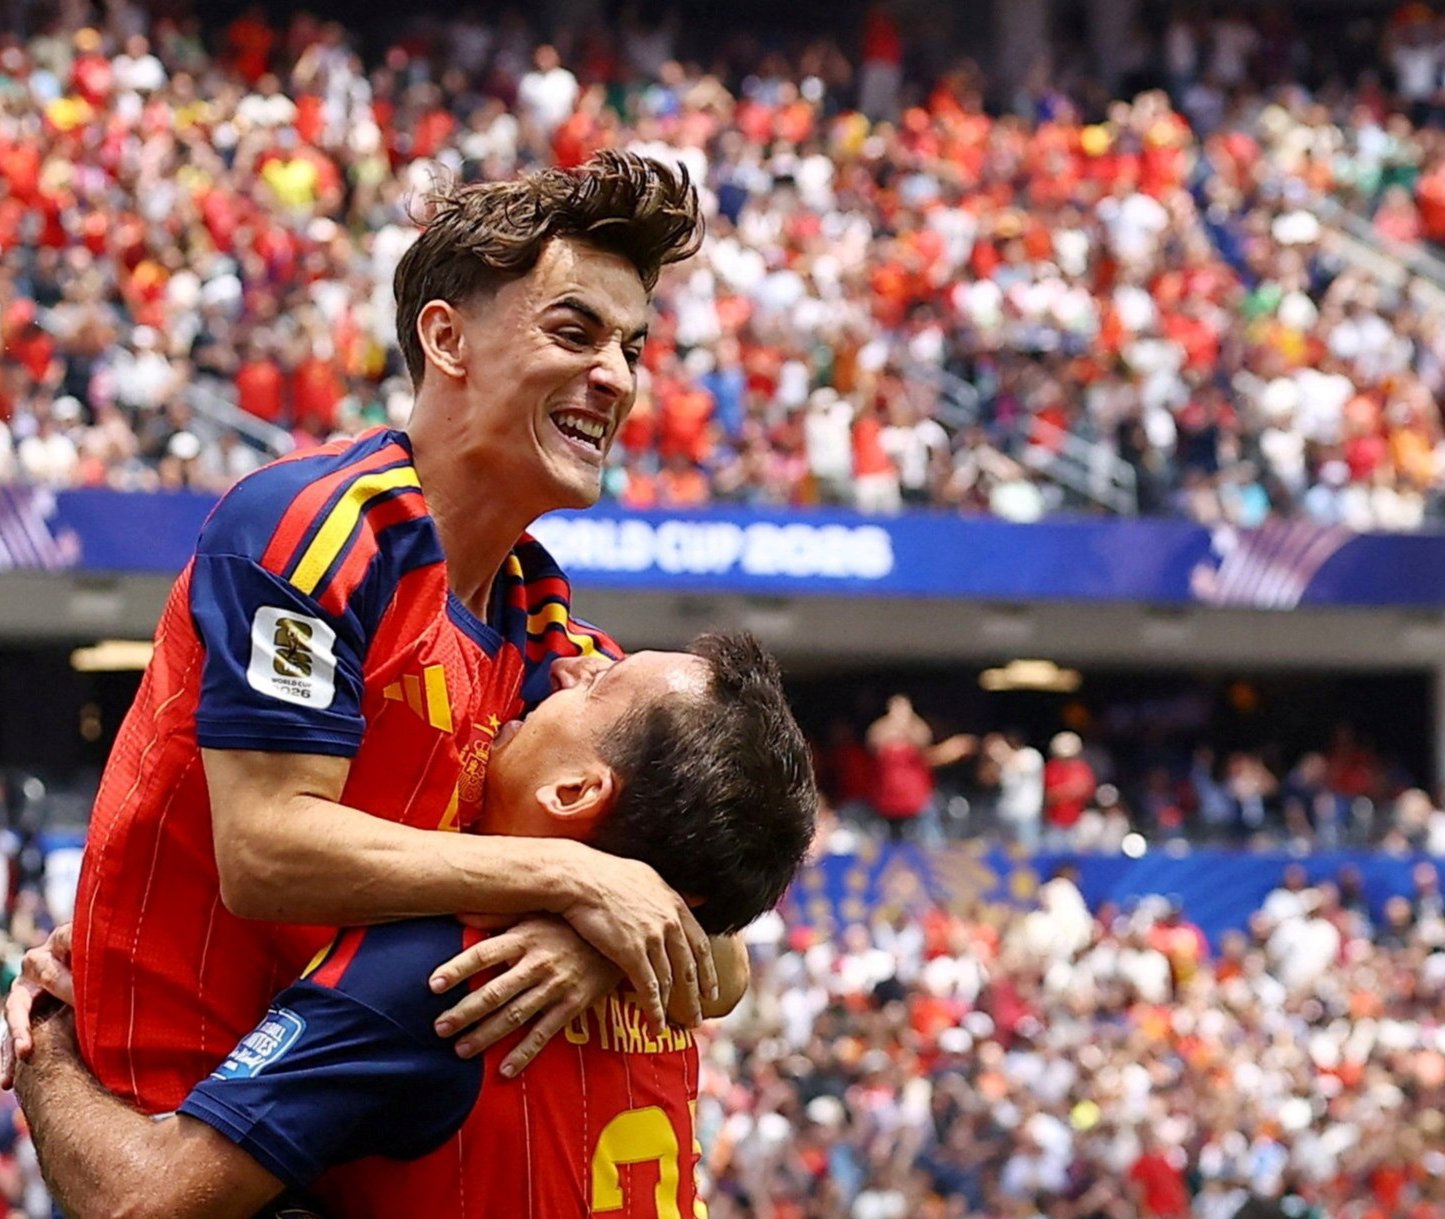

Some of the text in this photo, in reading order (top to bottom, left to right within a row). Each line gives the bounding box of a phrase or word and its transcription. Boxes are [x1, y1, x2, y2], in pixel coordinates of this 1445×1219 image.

[526, 516, 894, 579] ORLD CUP 2026
[271, 677, 298, 687] WORLD
